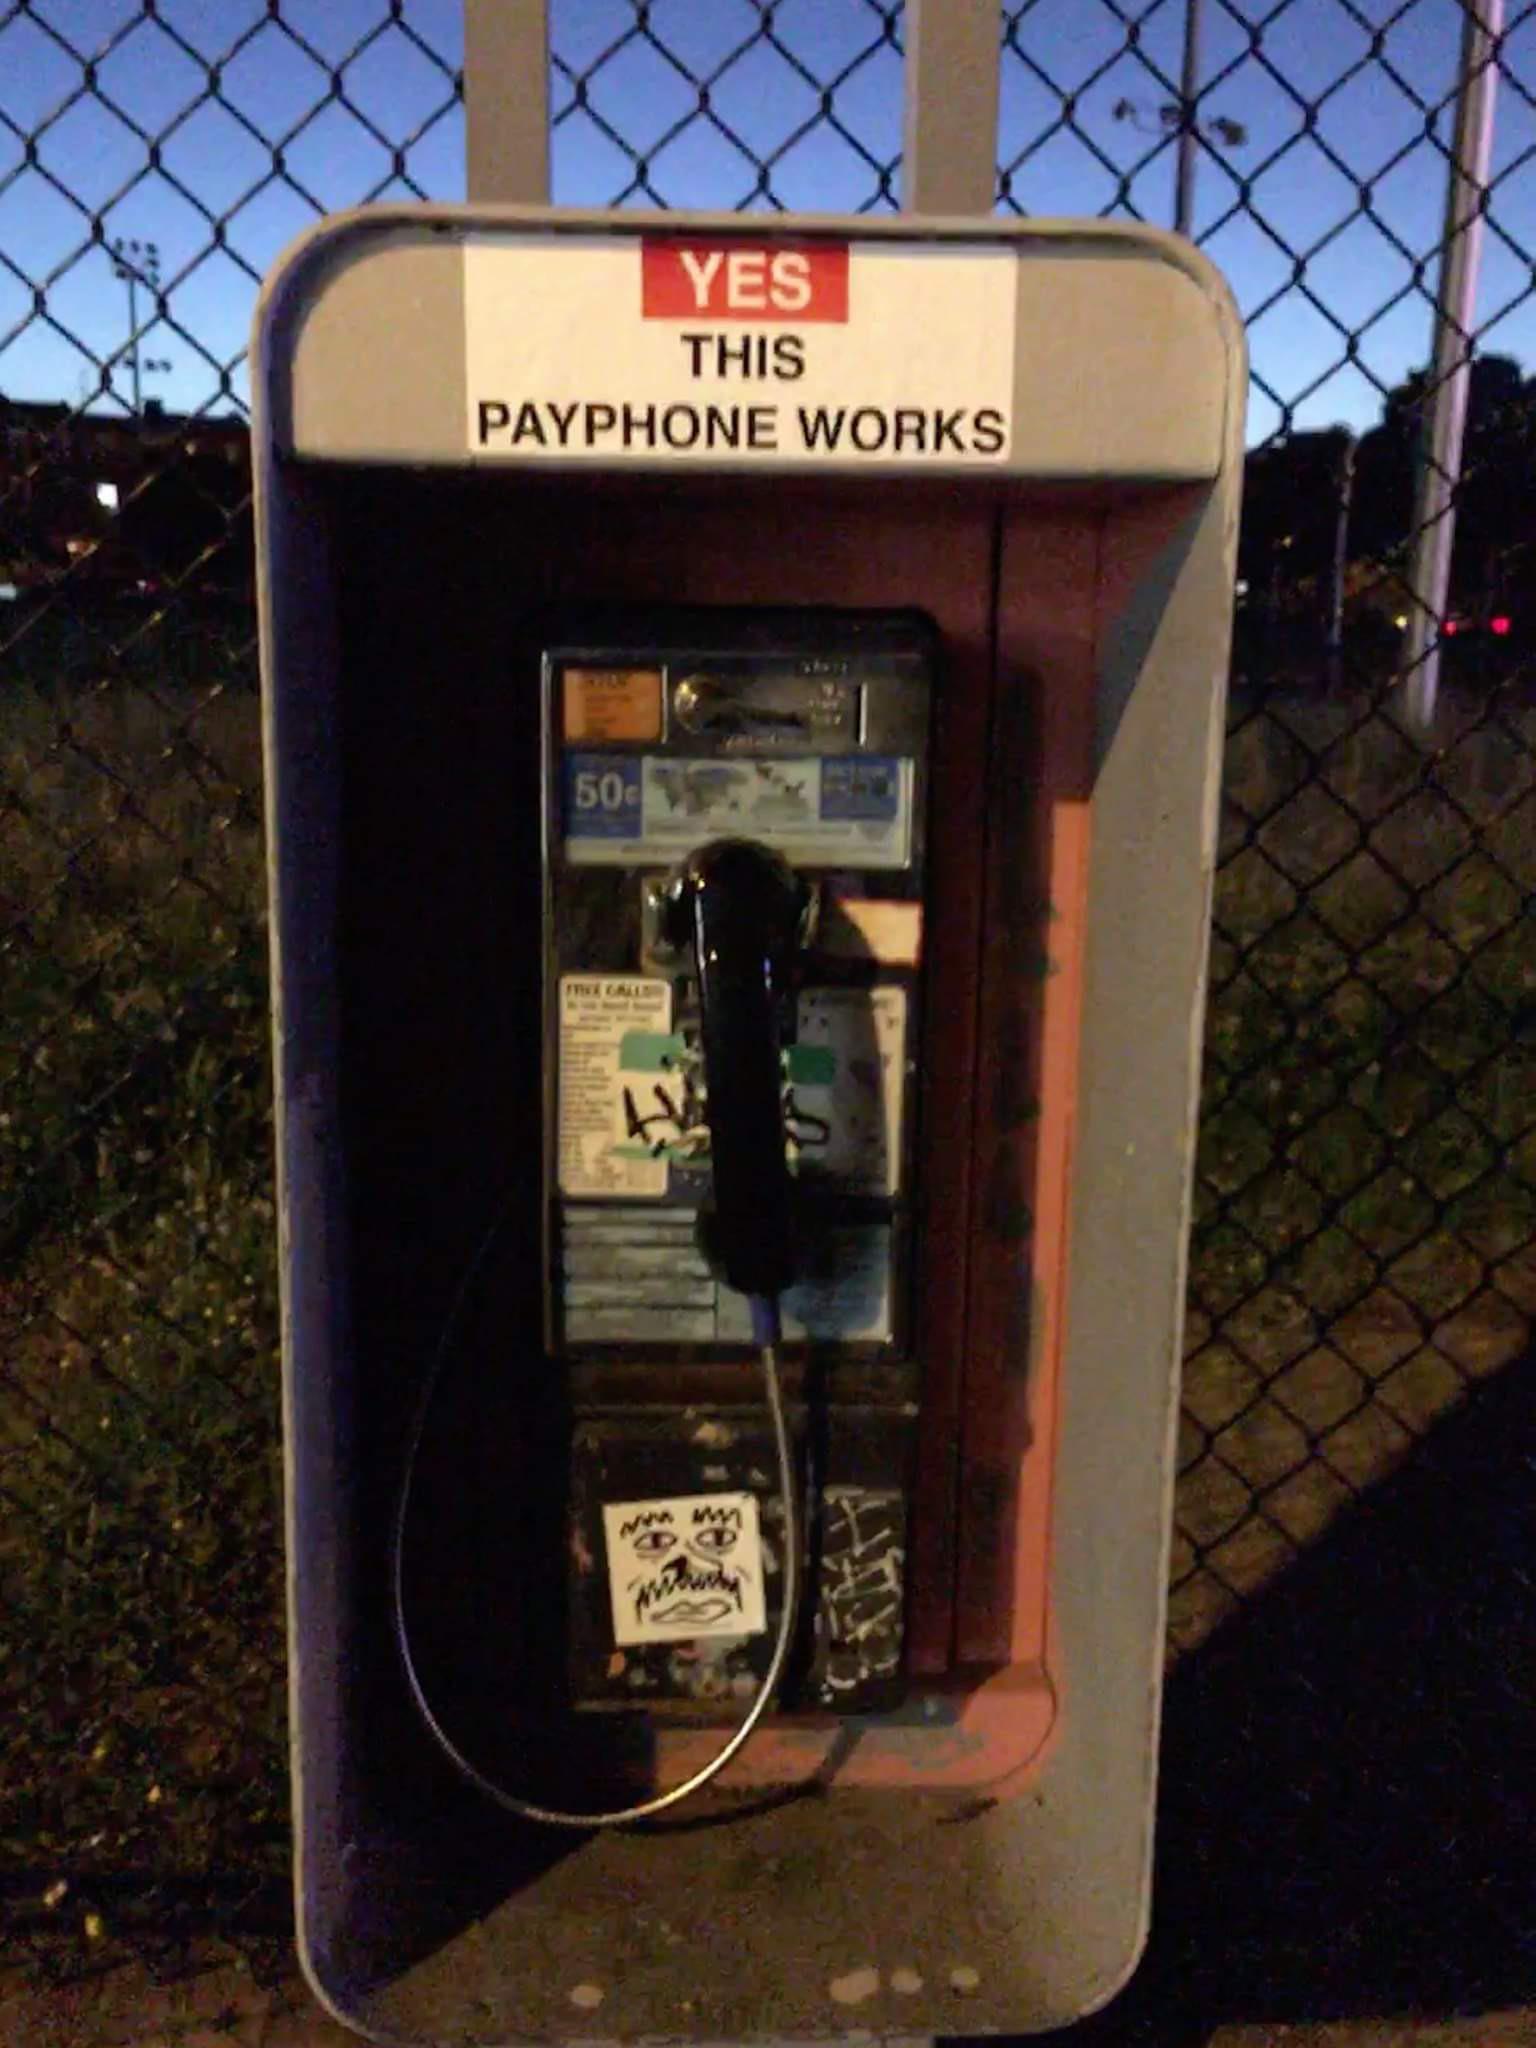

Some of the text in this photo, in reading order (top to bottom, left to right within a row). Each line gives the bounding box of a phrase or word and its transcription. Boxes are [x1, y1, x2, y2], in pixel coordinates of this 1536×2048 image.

[680, 250, 813, 311] YES
[680, 333, 806, 380] THIS
[478, 401, 1007, 454] PAYPHONE WORKS
